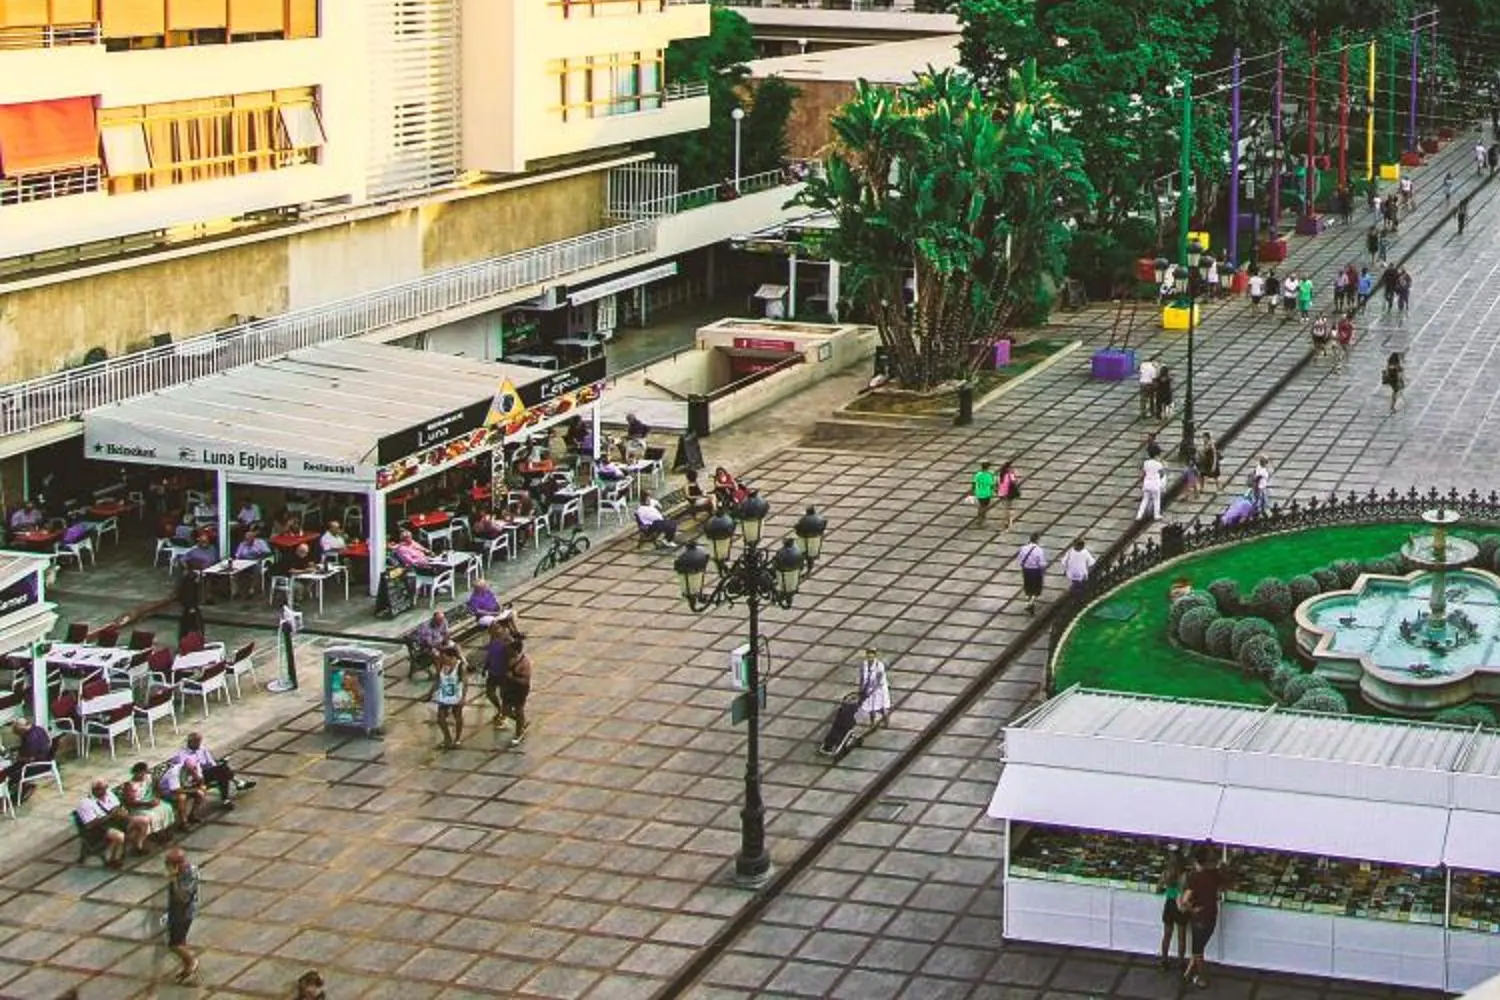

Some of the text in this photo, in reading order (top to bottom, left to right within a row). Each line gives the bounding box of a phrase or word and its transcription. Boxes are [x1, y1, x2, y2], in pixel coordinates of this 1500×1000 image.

[417, 427, 449, 447] Luna
[203, 449, 287, 470] Luna Egipcia
